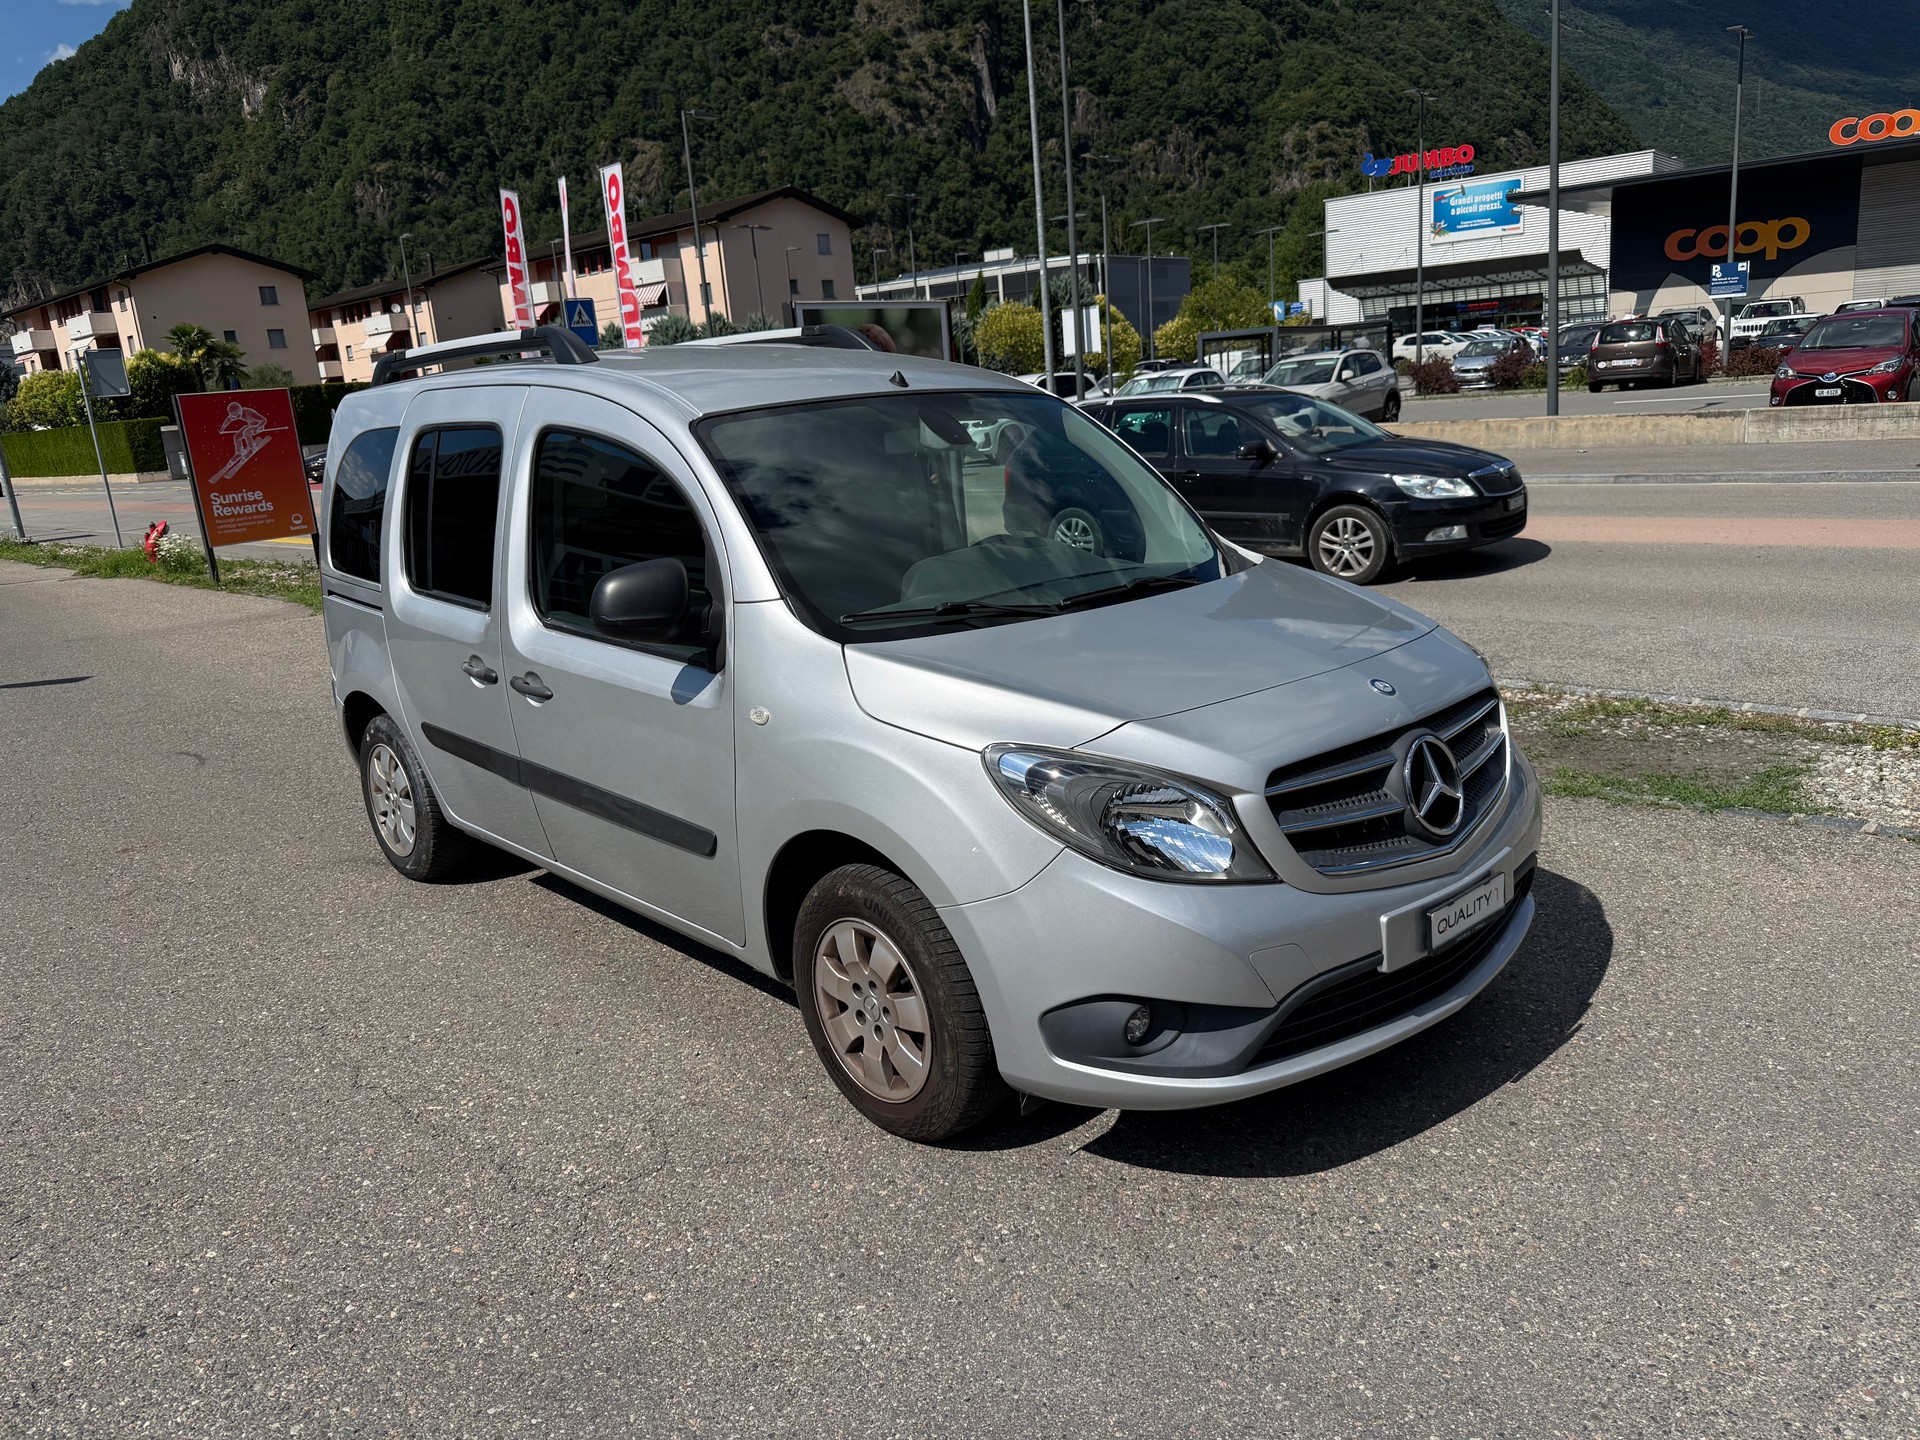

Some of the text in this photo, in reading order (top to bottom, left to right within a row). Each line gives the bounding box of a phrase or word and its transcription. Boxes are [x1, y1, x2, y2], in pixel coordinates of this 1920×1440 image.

[1390, 144, 1475, 175] JUMBO
[1450, 191, 1502, 206] Grandi progetti
[1456, 203, 1478, 215] piccoli
[1664, 217, 1811, 261] coop
[608, 173, 642, 350] JUMBO
[210, 489, 264, 505] Sunrise
[212, 500, 274, 517] Rewards
[1437, 890, 1492, 934] QUALITY
